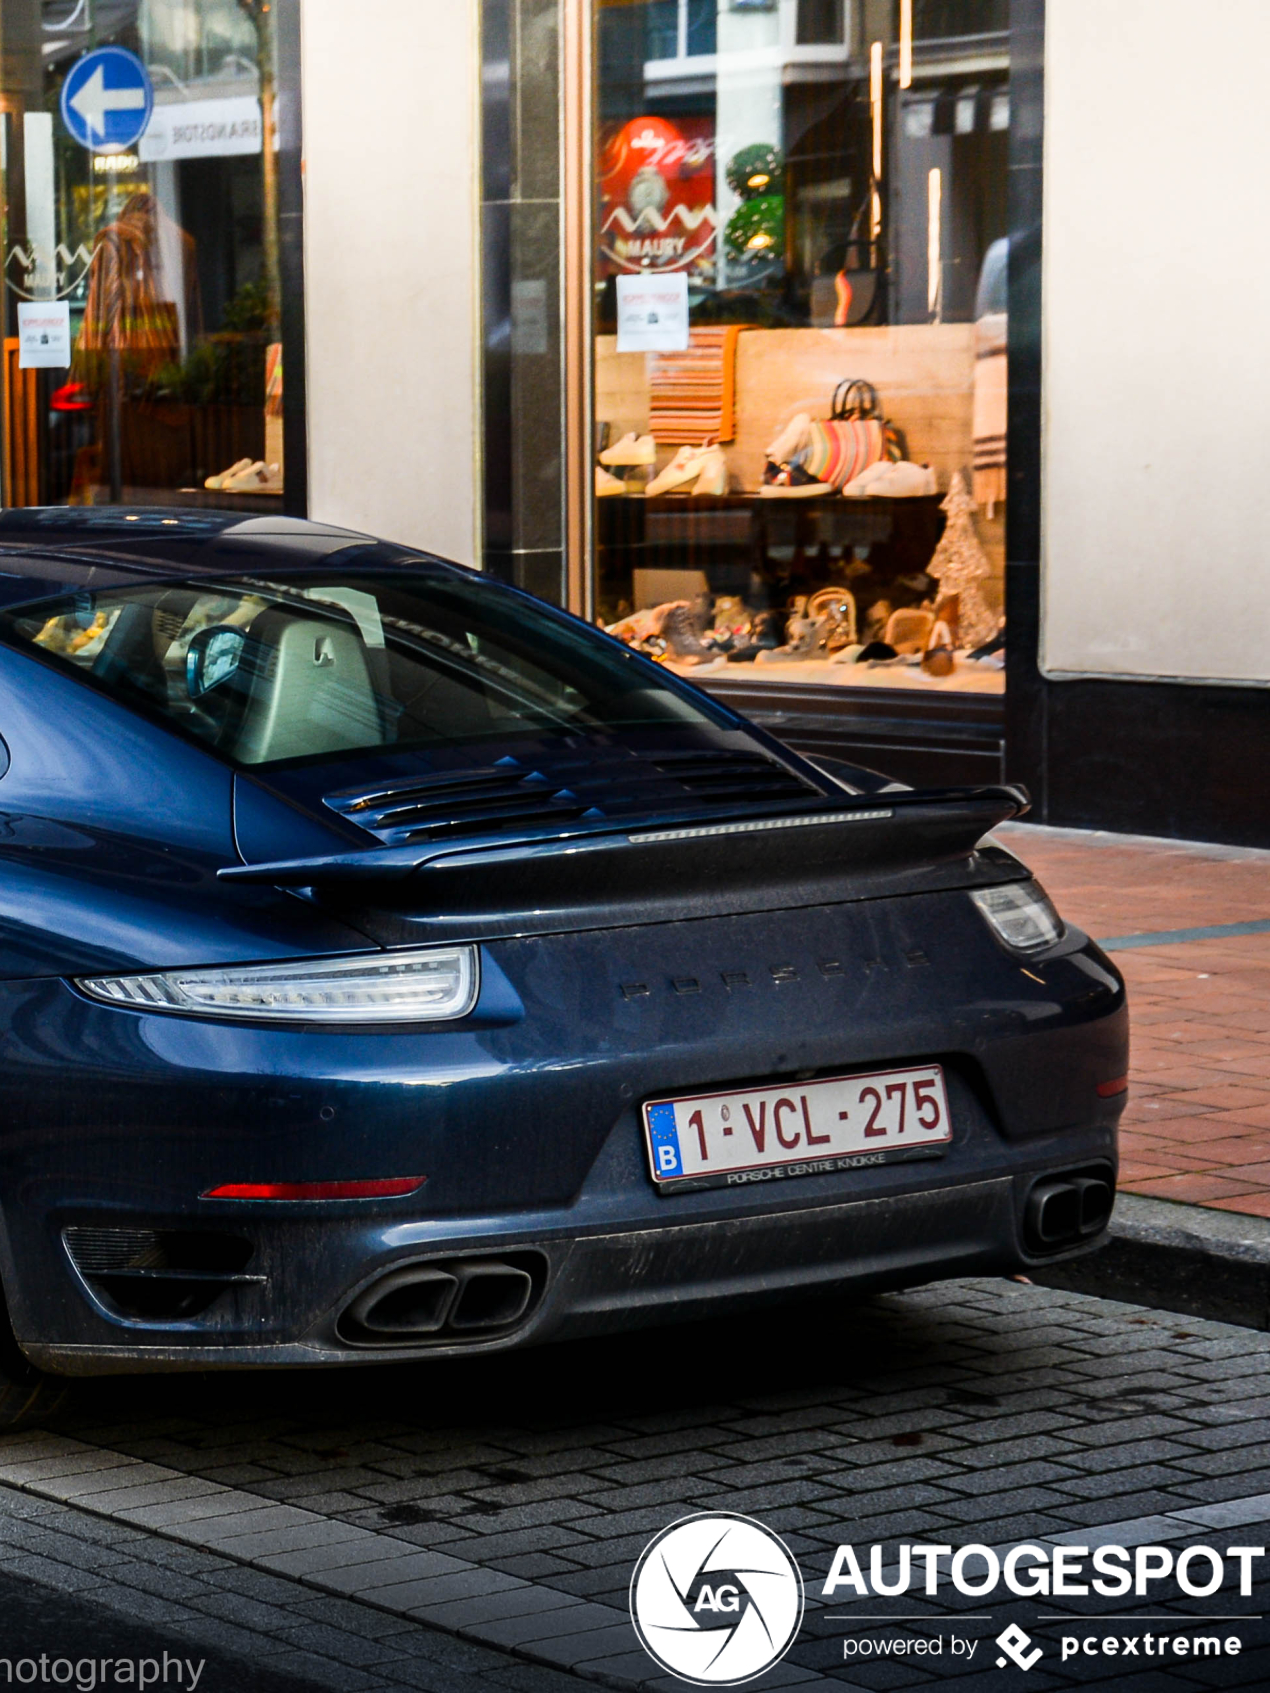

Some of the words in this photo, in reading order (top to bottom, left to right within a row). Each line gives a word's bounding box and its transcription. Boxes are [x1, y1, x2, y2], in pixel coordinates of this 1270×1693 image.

[625, 237, 686, 257] MAURY
[621, 951, 930, 1001] PORSCHE
[657, 1145, 677, 1171] B
[727, 1167, 785, 1184] PORSCHE
[787, 1160, 835, 1176] CENTRE
[837, 1153, 886, 1169] KNOKKE
